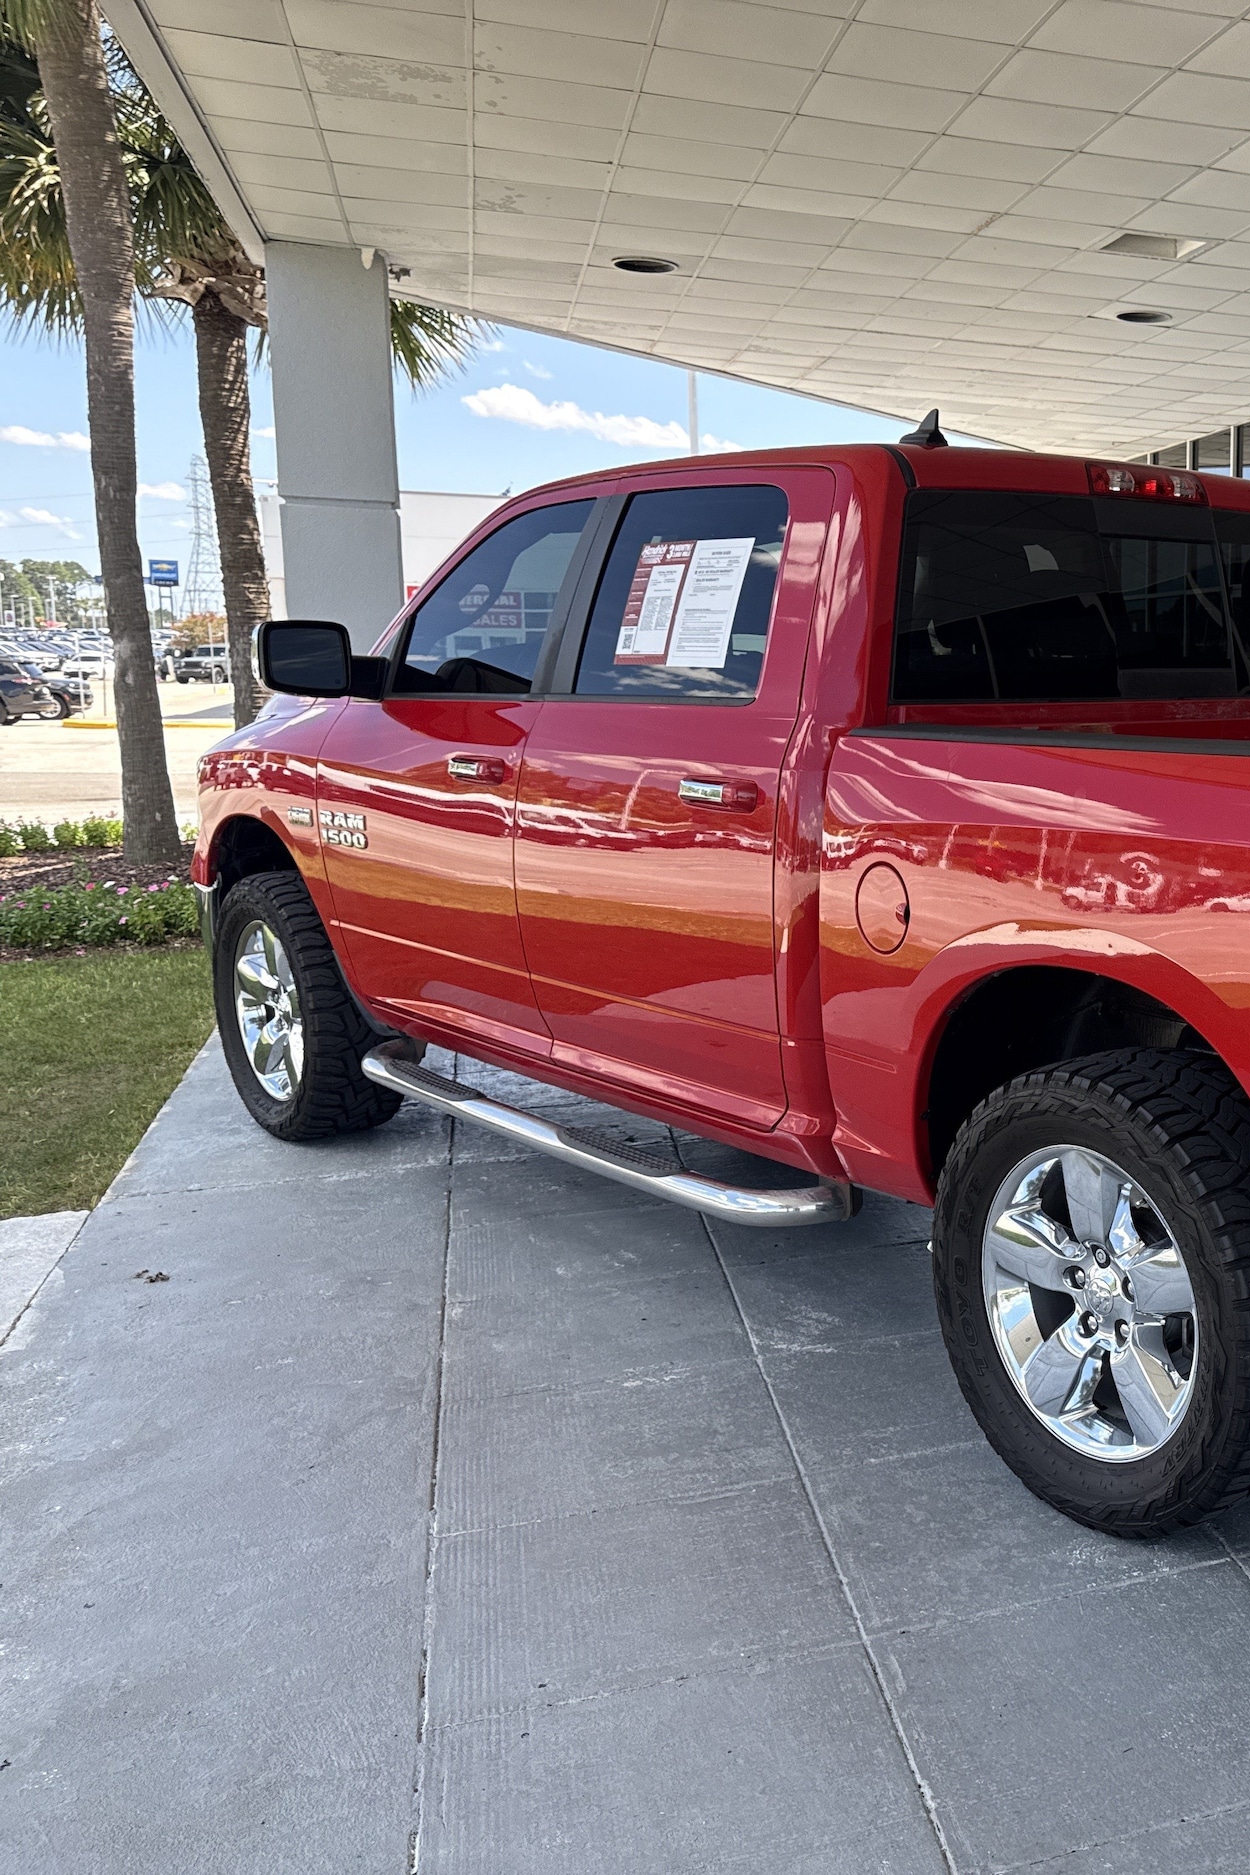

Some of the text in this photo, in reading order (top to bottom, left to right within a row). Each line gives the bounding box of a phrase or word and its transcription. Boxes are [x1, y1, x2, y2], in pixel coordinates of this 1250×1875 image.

[319, 810, 367, 831] RAM
[320, 829, 369, 850] 1500
[954, 1255, 988, 1376] TOYO
